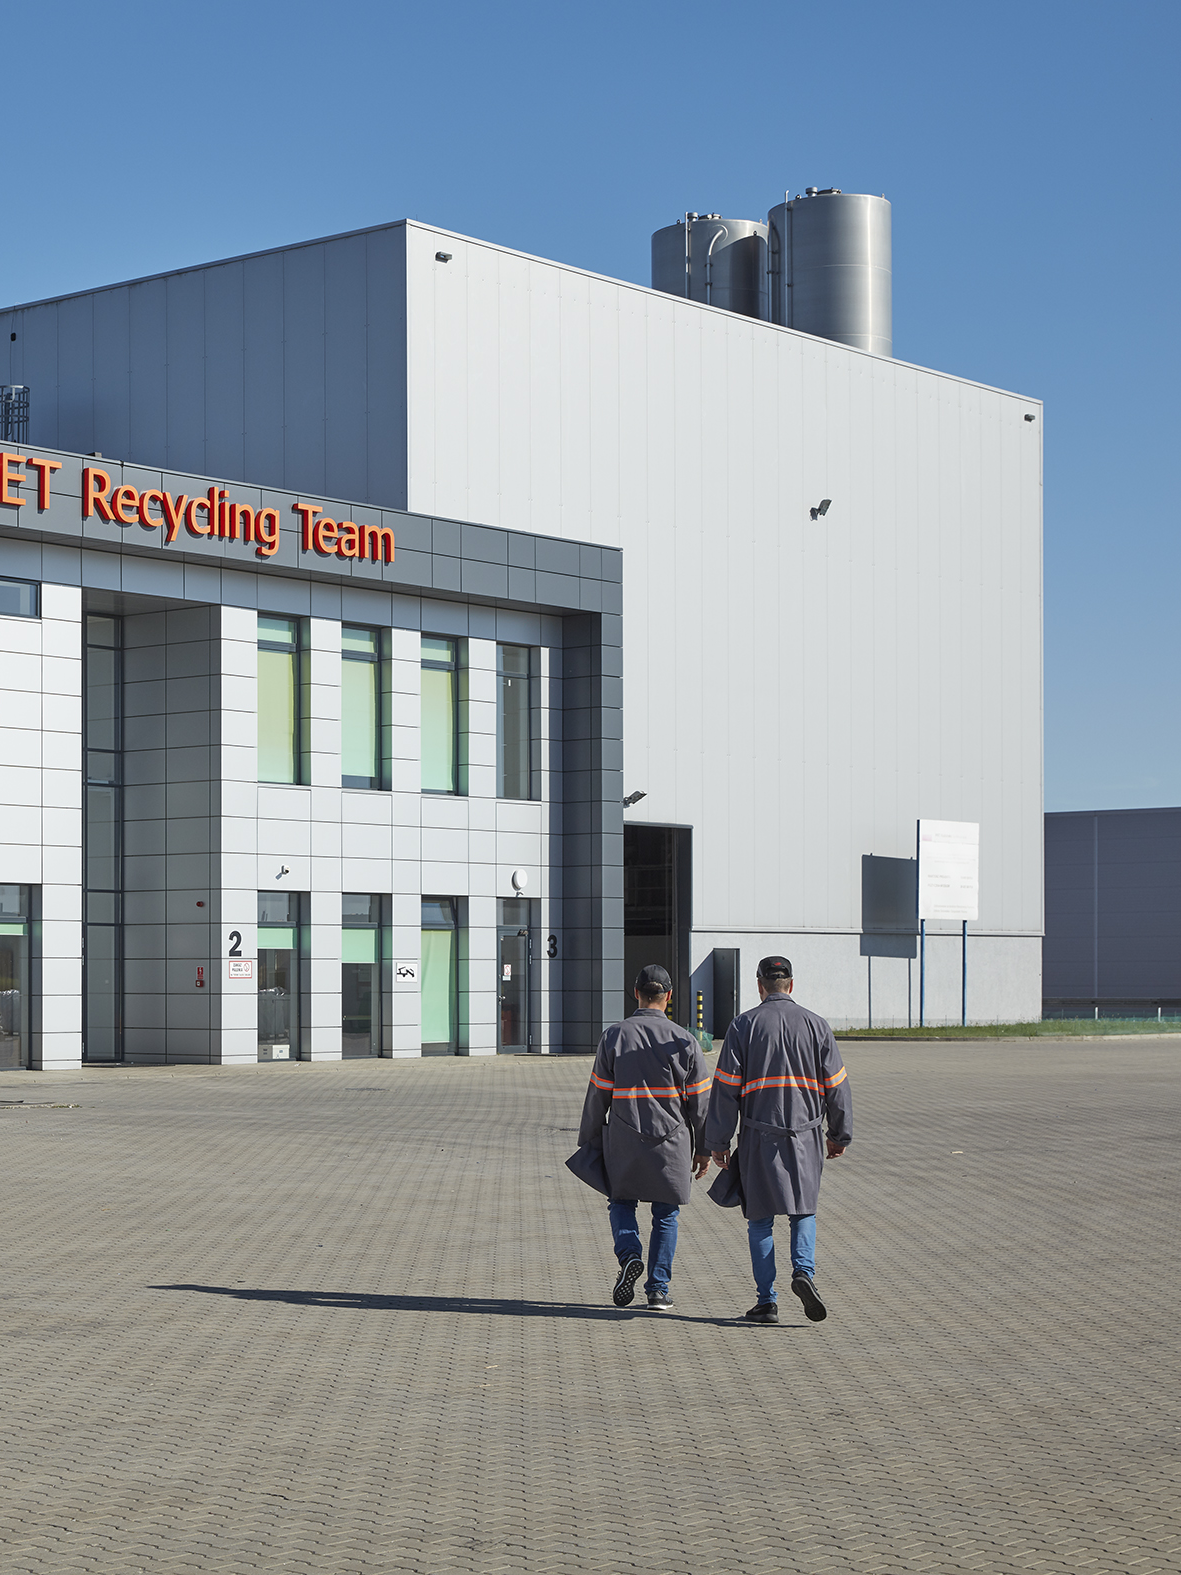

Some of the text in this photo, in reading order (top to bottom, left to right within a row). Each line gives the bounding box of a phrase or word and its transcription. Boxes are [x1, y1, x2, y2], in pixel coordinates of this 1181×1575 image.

[82, 467, 280, 557] Recycling
[293, 502, 395, 564] Team
[229, 930, 242, 957] 2
[547, 934, 558, 958] 3
